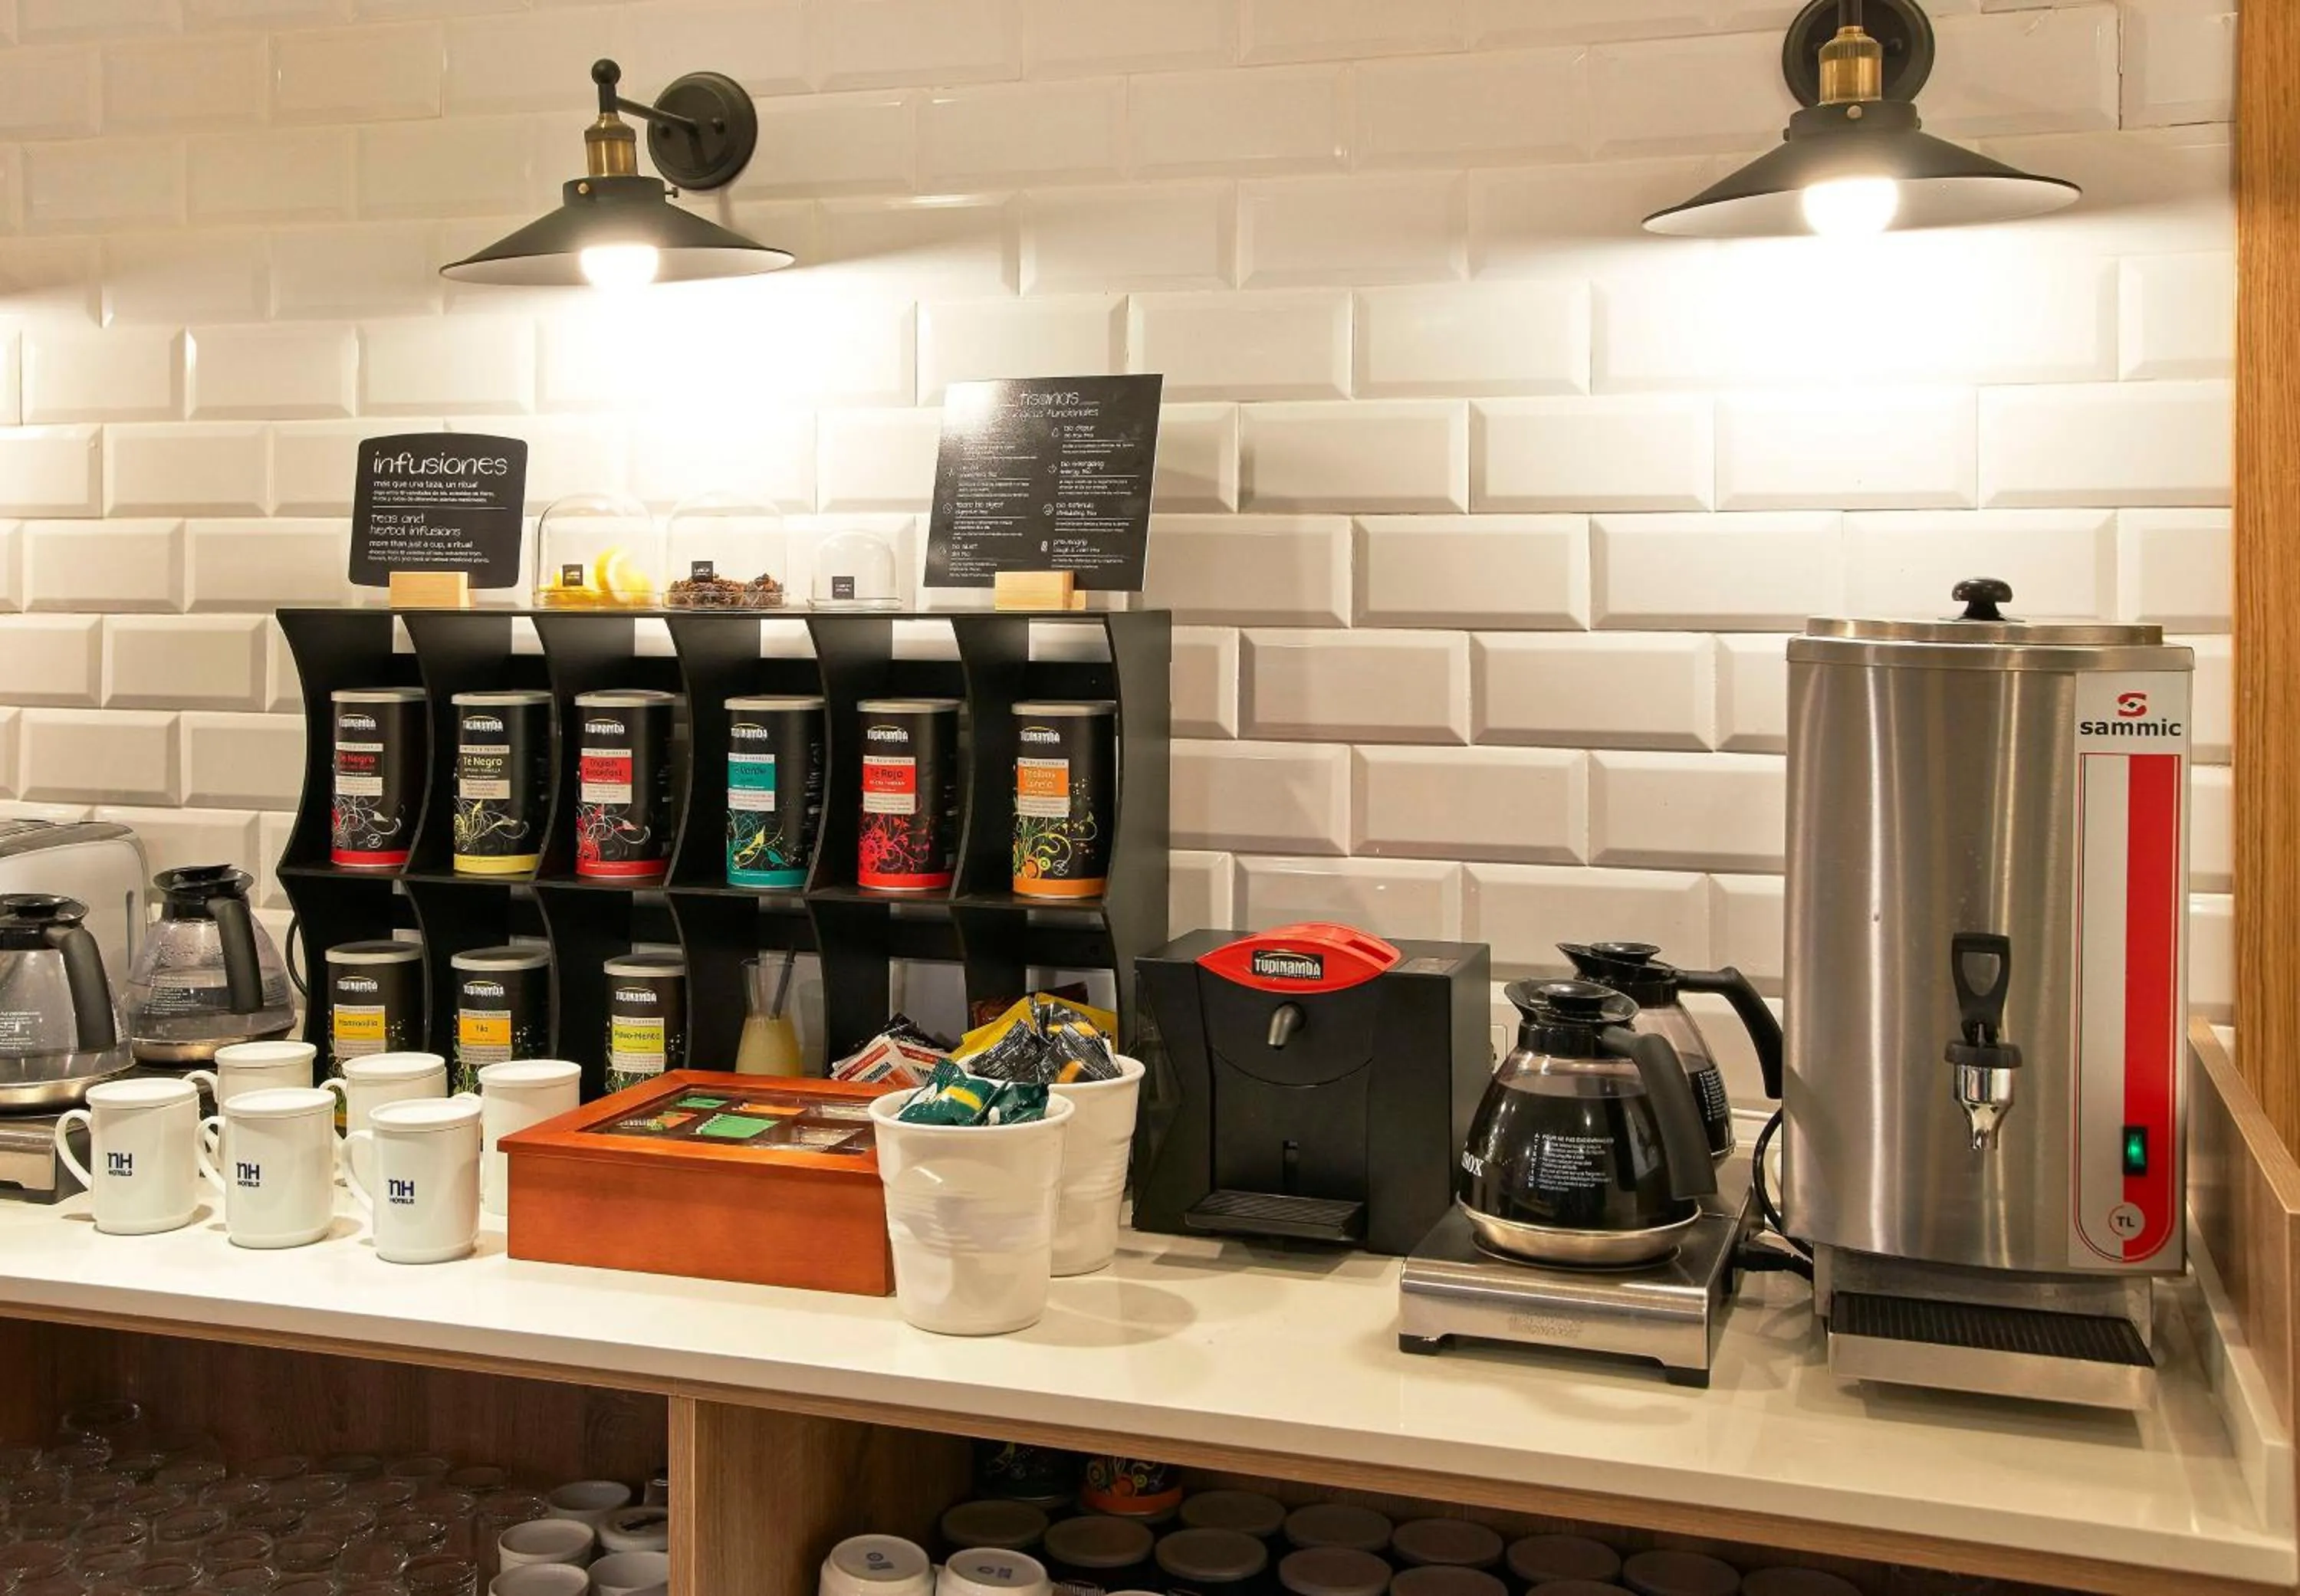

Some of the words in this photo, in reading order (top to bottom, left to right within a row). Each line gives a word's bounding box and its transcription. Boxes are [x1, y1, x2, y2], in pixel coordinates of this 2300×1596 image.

[373, 451, 507, 475] infusiones
[401, 513, 425, 524] and
[370, 524, 406, 536] herbal
[409, 525, 461, 537] infusions
[2072, 718, 2181, 737] sammic
[463, 754, 473, 766] Té
[474, 756, 503, 769] Negro
[2115, 1216, 2135, 1228] TL
